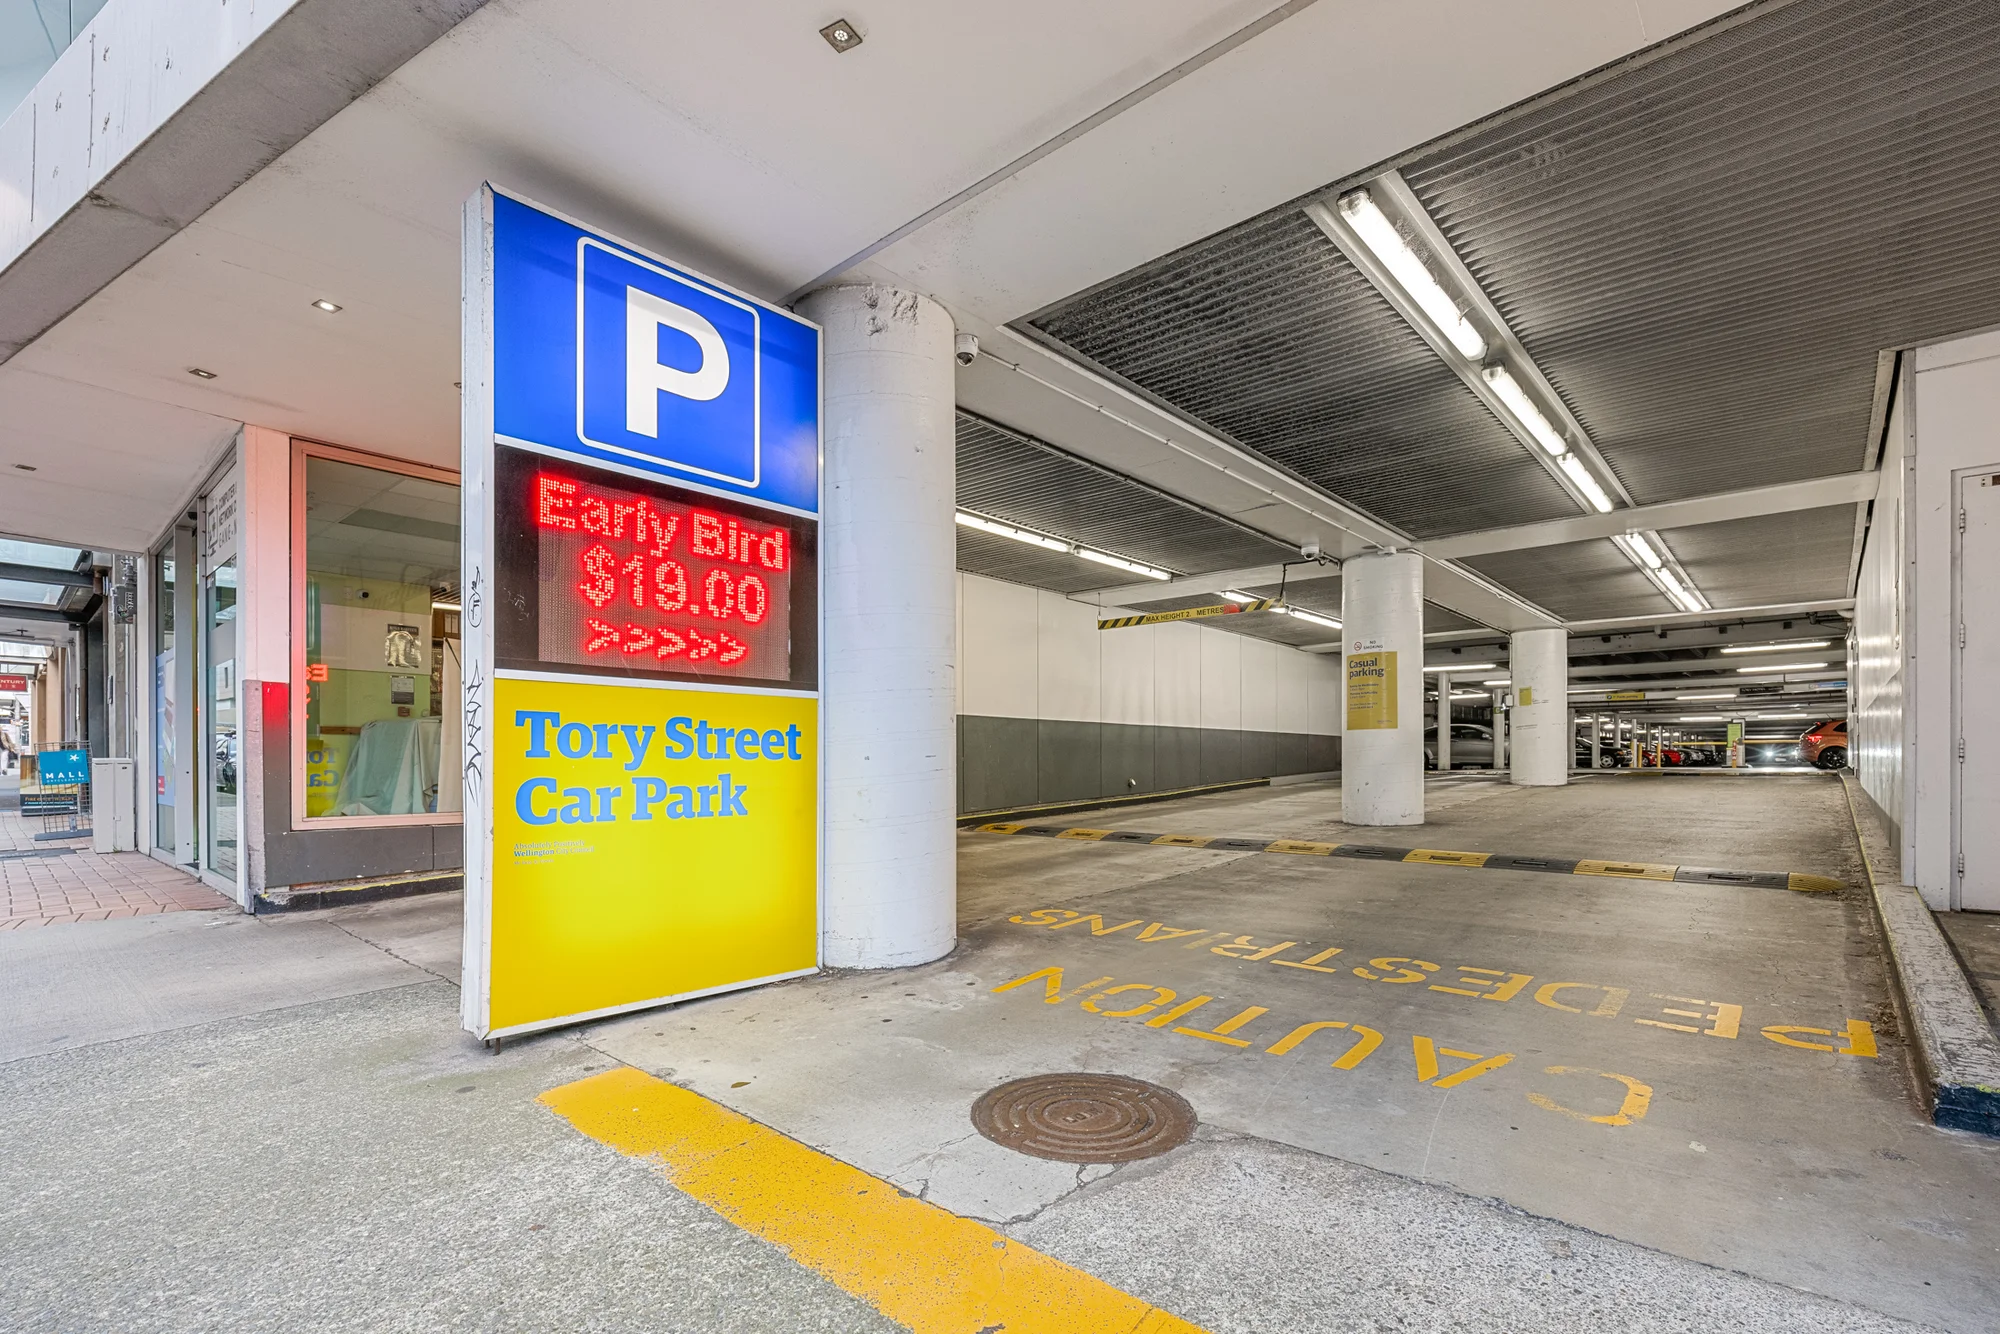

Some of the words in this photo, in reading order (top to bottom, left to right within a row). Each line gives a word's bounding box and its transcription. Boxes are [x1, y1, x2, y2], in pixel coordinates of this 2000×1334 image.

[626, 285, 731, 440] P
[537, 477, 679, 557] Early
[692, 512, 786, 571] Bird
[580, 544, 766, 624] $19.00
[1146, 614, 1159, 622] MAX
[1161, 612, 1184, 621] HEIGHT
[1197, 607, 1224, 616] METRES
[1349, 657, 1378, 669] Casual
[1349, 667, 1385, 680] parking
[515, 710, 656, 771] Tory
[665, 716, 802, 760] Street
[45, 771, 84, 779] MALL
[515, 777, 622, 826] Car
[631, 773, 748, 820] Park
[513, 849, 555, 857] Wellington
[514, 842, 552, 850] Absolutely
[554, 839, 586, 847] Positively
[1008, 909, 1879, 1058] PEDESTRIANS
[990, 966, 1654, 1127] CAUTION
